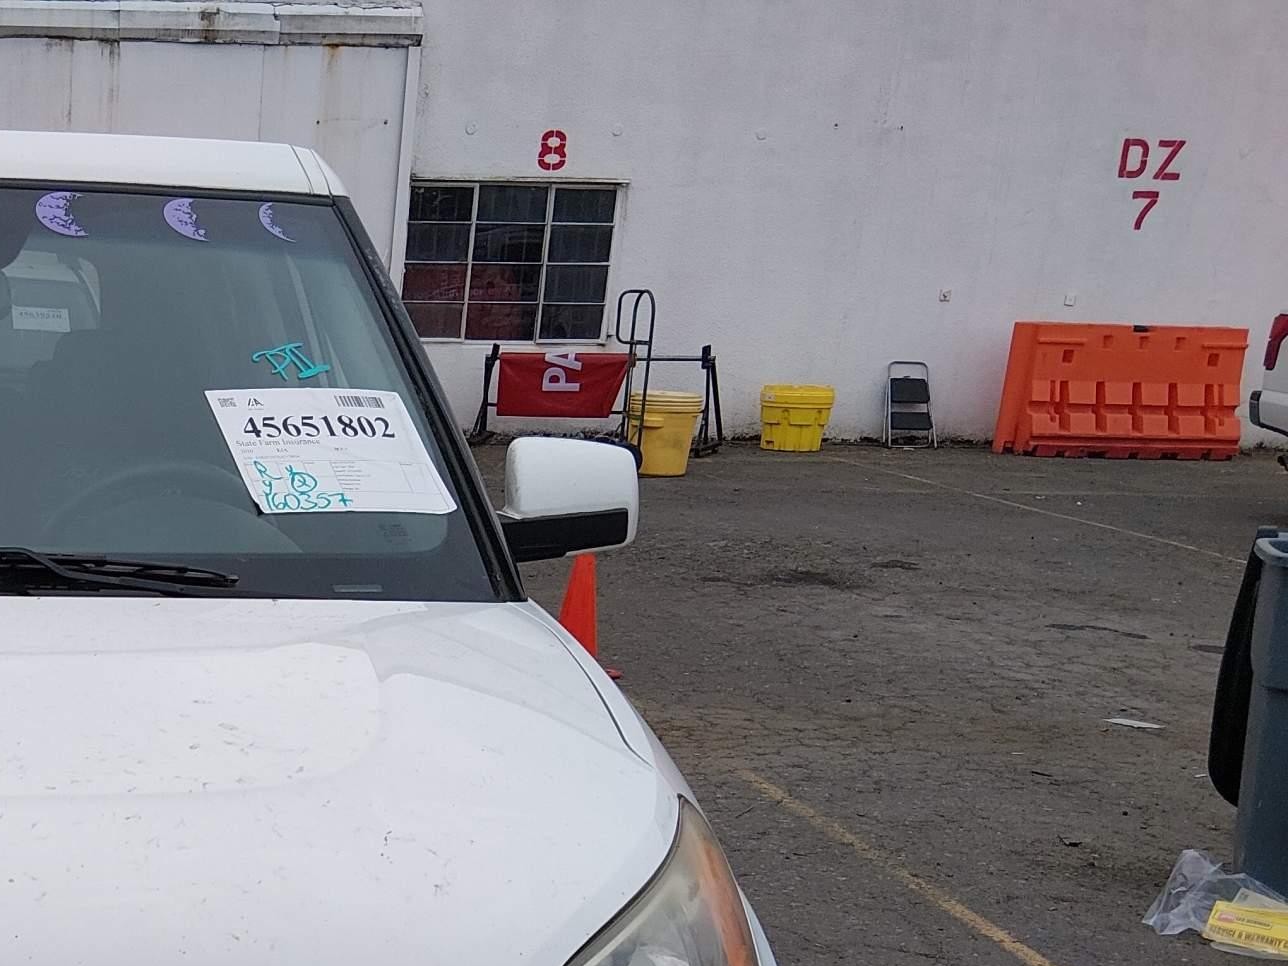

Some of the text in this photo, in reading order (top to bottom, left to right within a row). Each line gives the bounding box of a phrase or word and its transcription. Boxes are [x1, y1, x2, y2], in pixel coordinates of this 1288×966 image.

[537, 129, 568, 172] 8
[1117, 138, 1187, 182] DZ
[1131, 190, 1160, 231] 7
[243, 414, 396, 438] 45651802
